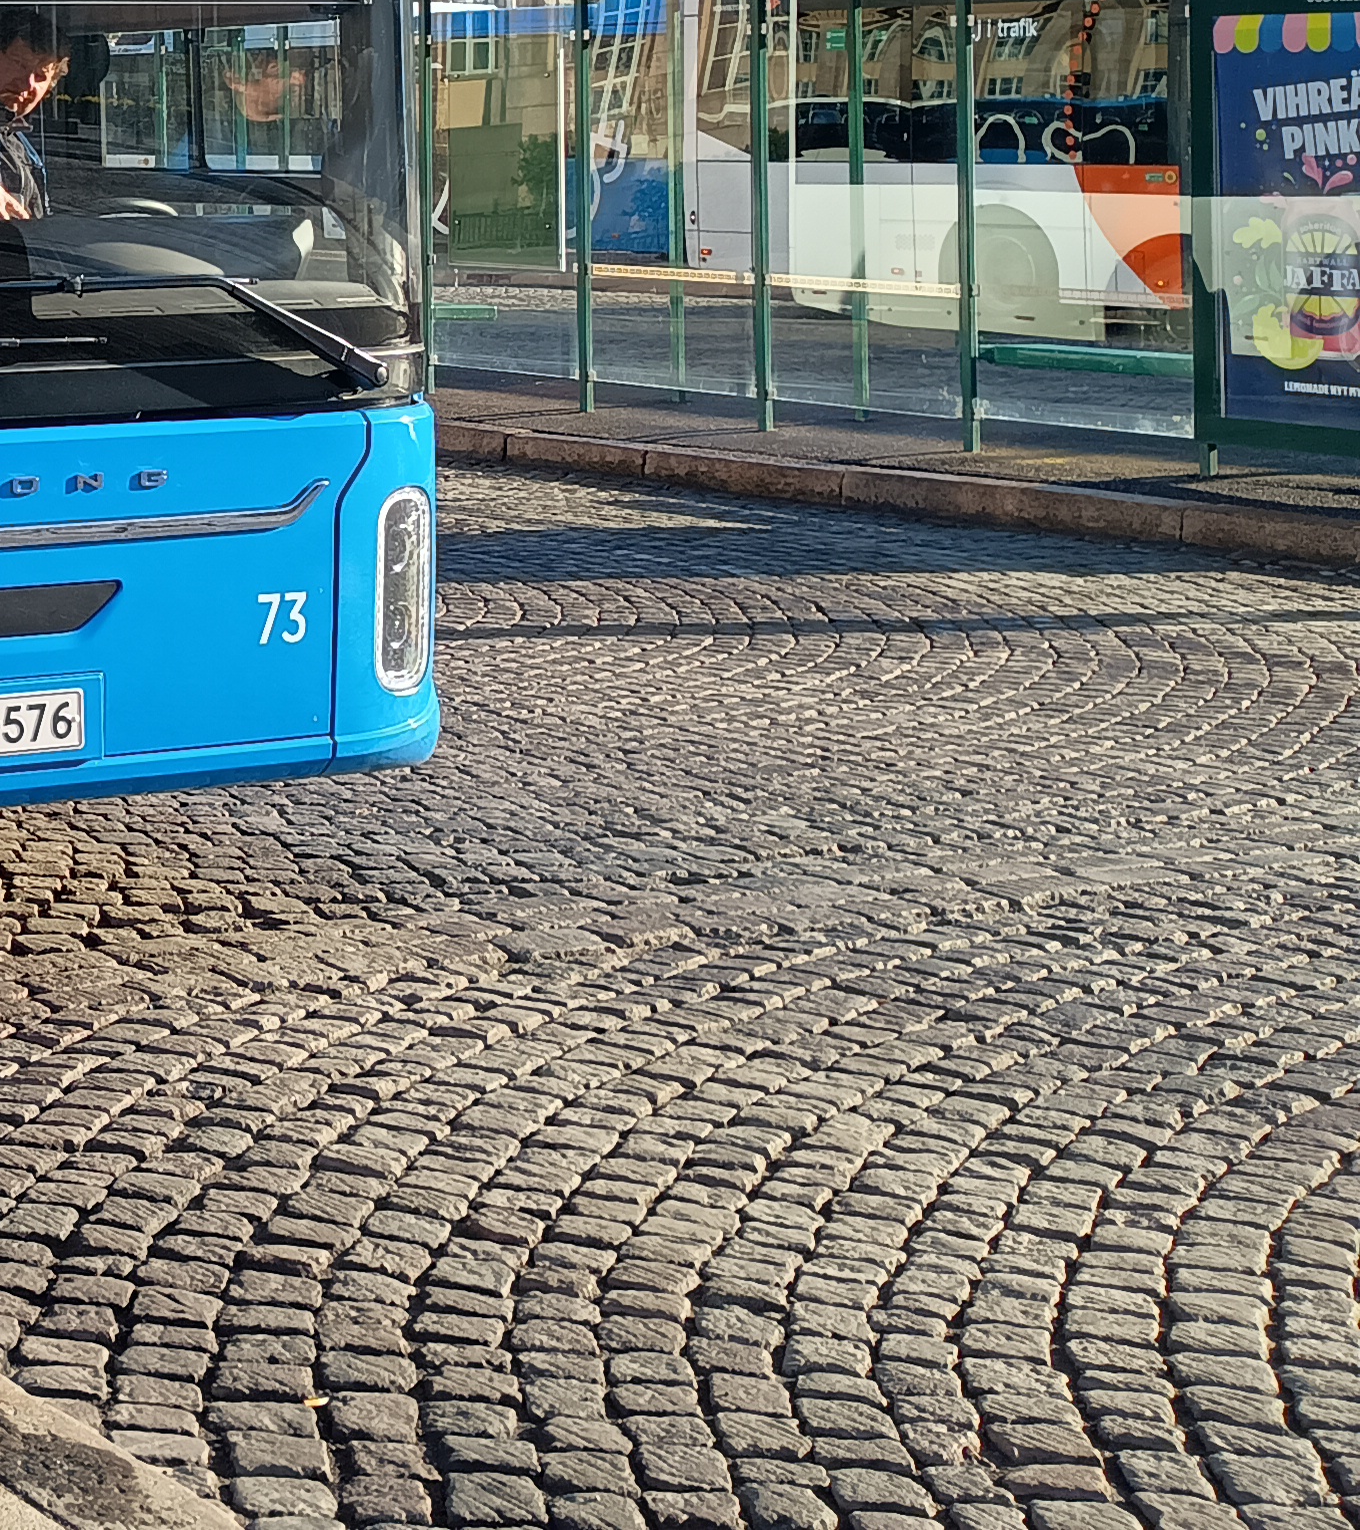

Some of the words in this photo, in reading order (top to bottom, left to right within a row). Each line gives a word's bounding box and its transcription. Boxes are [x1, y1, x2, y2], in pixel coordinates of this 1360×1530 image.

[998, 17, 1038, 37] trafik
[1284, 265, 1360, 291] JAFFA
[258, 591, 307, 645] 73
